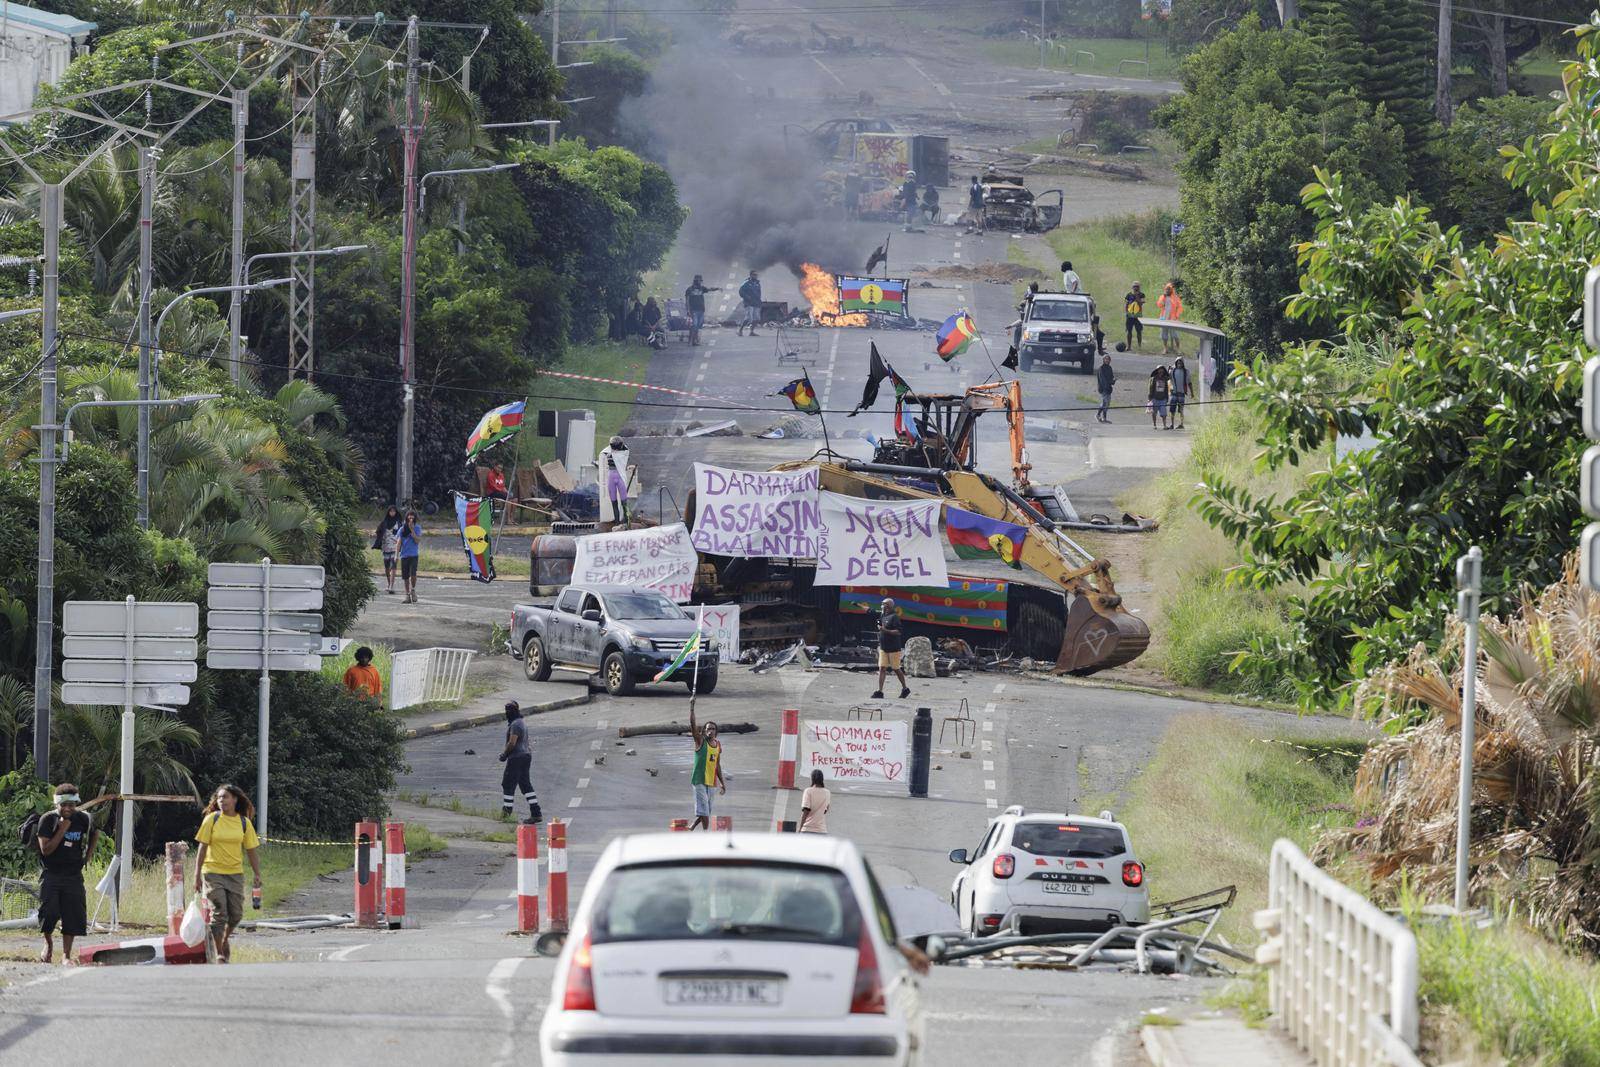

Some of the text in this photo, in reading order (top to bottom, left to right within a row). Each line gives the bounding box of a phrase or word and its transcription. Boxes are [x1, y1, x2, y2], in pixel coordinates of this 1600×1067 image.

[703, 469, 819, 497] DARMANIN
[699, 500, 820, 535] ASSASSIN
[845, 505, 935, 538] NON
[861, 534, 900, 557] AU
[593, 553, 639, 568] BAKES
[846, 550, 931, 581] DÉGEL
[815, 725, 892, 741] HOMMAGE
[845, 742, 868, 752] TOUS
[871, 743, 886, 752] NOS
[1042, 873, 1095, 882] DUSTER
[1062, 883, 1077, 893] 720
